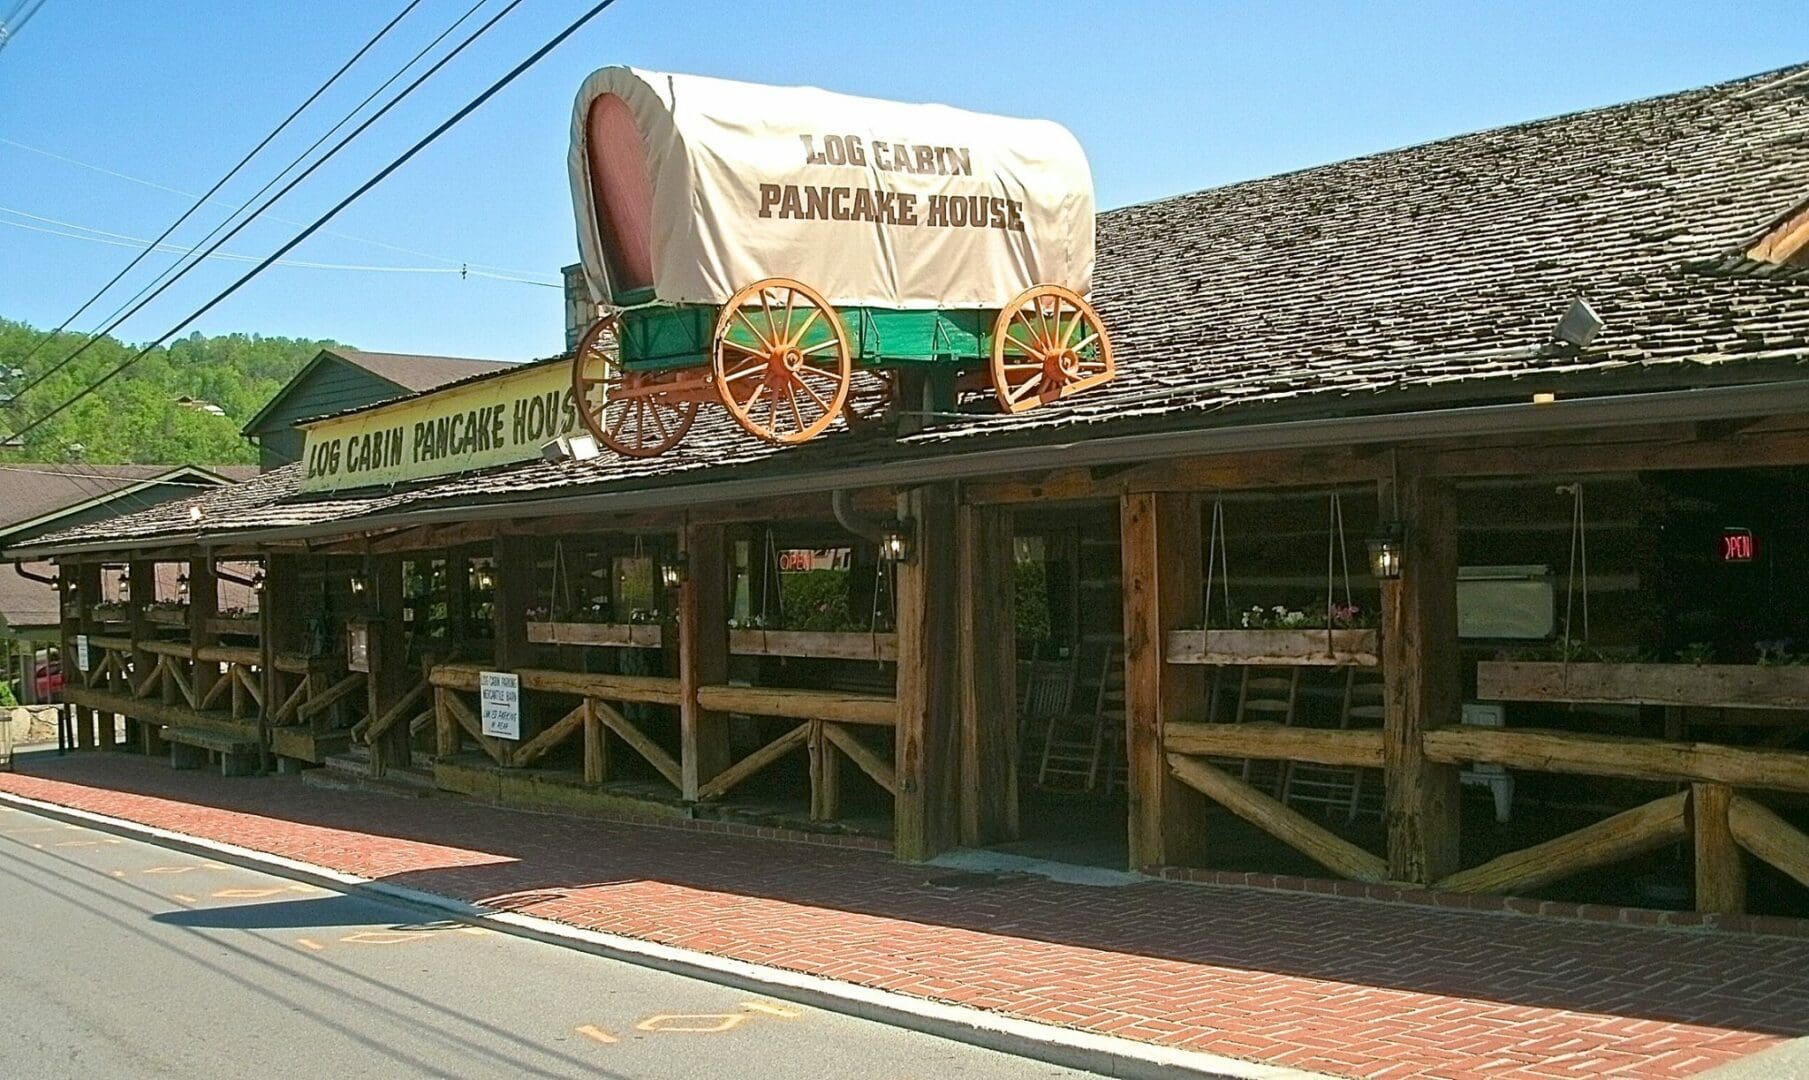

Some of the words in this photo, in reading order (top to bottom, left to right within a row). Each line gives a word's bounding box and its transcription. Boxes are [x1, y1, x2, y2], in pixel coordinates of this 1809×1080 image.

[800, 134, 867, 167] LOG
[871, 140, 973, 176] CABIN
[758, 183, 918, 227] PANCAKE
[927, 194, 1025, 232] HOUSE
[308, 438, 341, 479] LOG
[346, 427, 404, 473] CABIN
[413, 403, 505, 463] PANCAKE
[780, 553, 811, 571] OPEN
